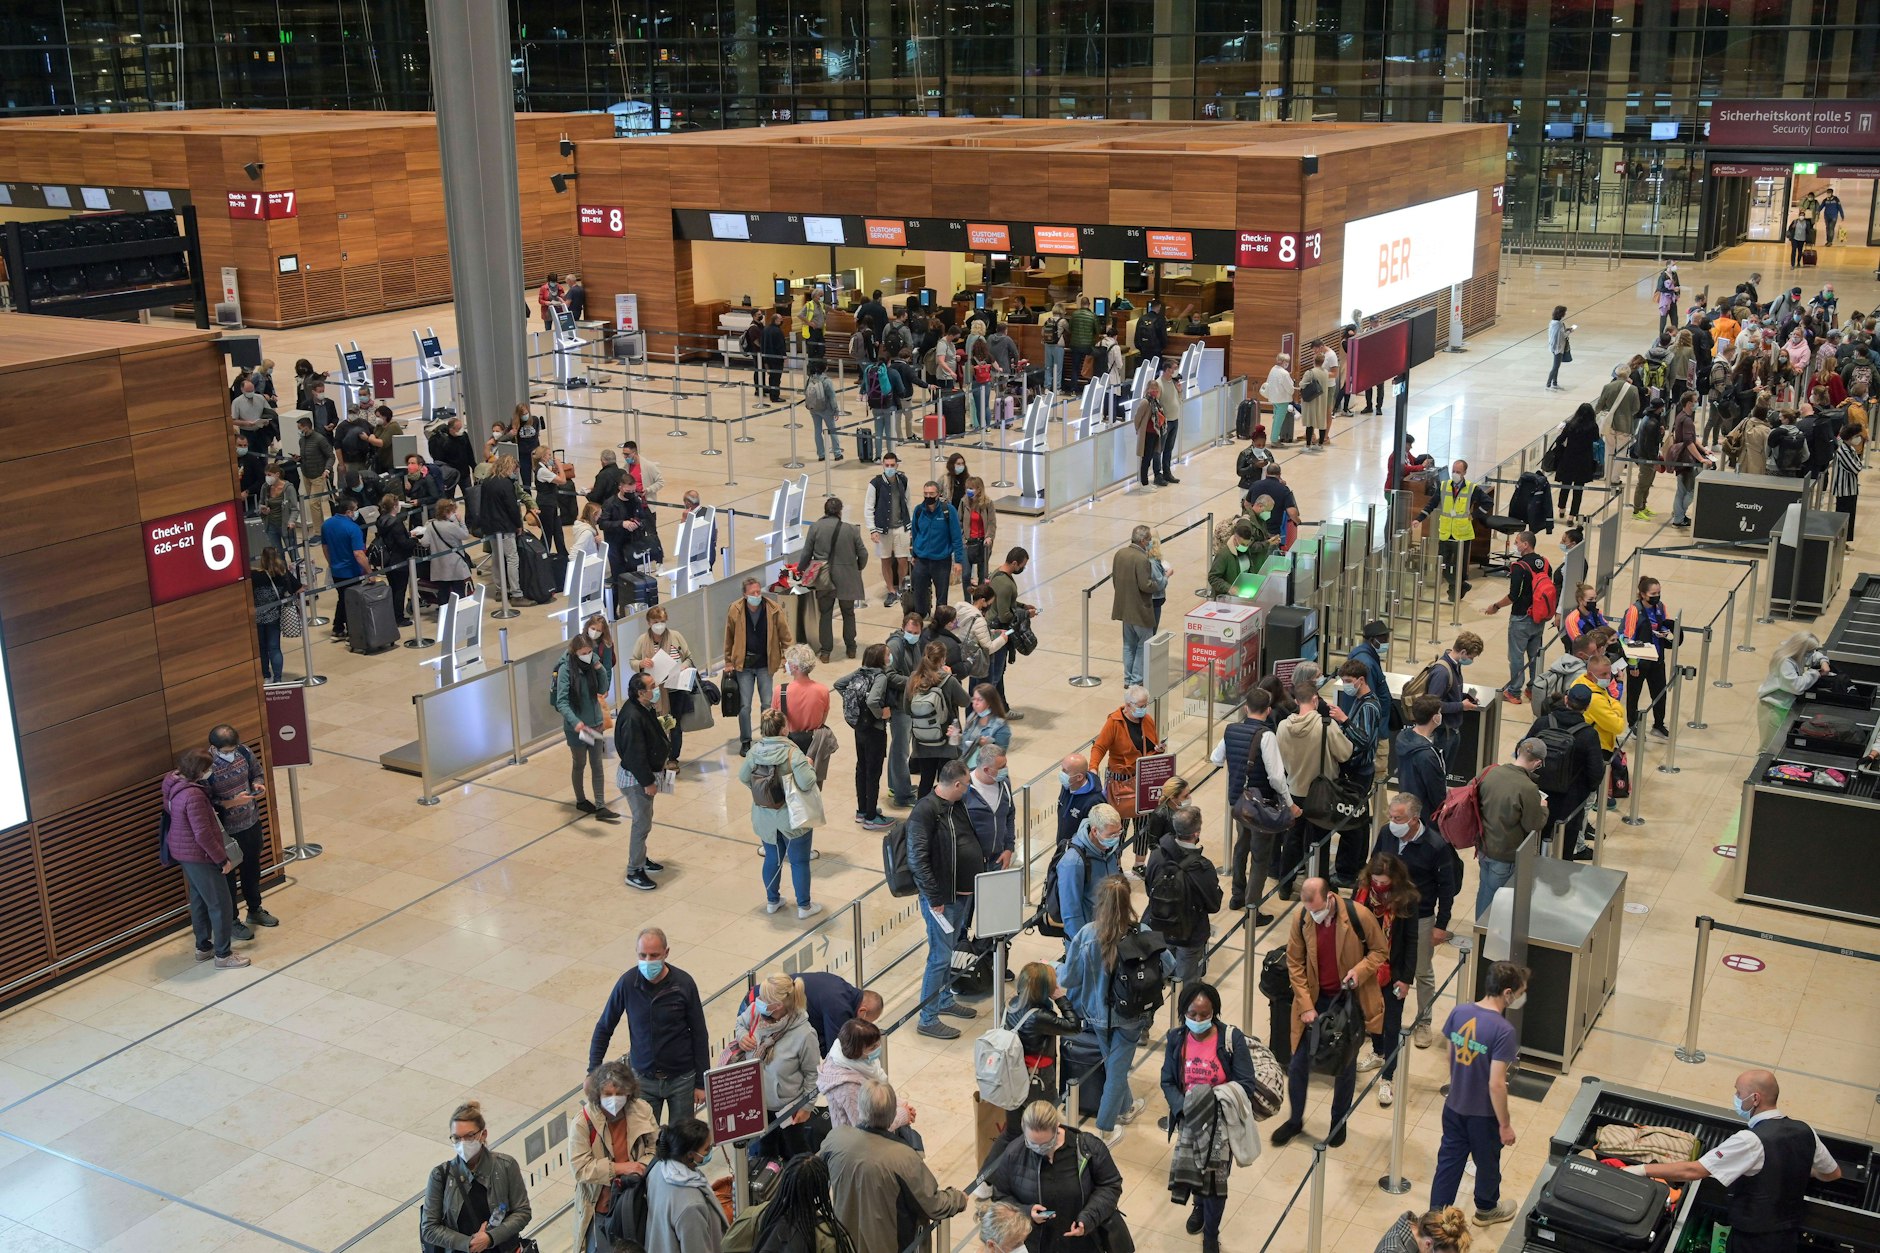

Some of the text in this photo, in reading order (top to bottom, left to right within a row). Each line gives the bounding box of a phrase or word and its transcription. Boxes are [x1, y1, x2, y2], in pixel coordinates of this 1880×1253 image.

[1844, 112, 1851, 122] 5
[1772, 125, 1849, 136] Security Control
[252, 194, 261, 214] 7
[284, 192, 294, 212] 7
[610, 210, 622, 231] 8
[1241, 234, 1271, 242] Check-in
[1314, 233, 1320, 259] 8
[1279, 236, 1296, 262] 8
[1378, 237, 1411, 288] BER
[1736, 502, 1763, 511] Security
[152, 521, 194, 540] Check-in
[202, 511, 234, 571] 6
[1187, 622, 1202, 631] BER
[1192, 648, 1216, 656] SPENDE
[1570, 1162, 1598, 1176] THULE
